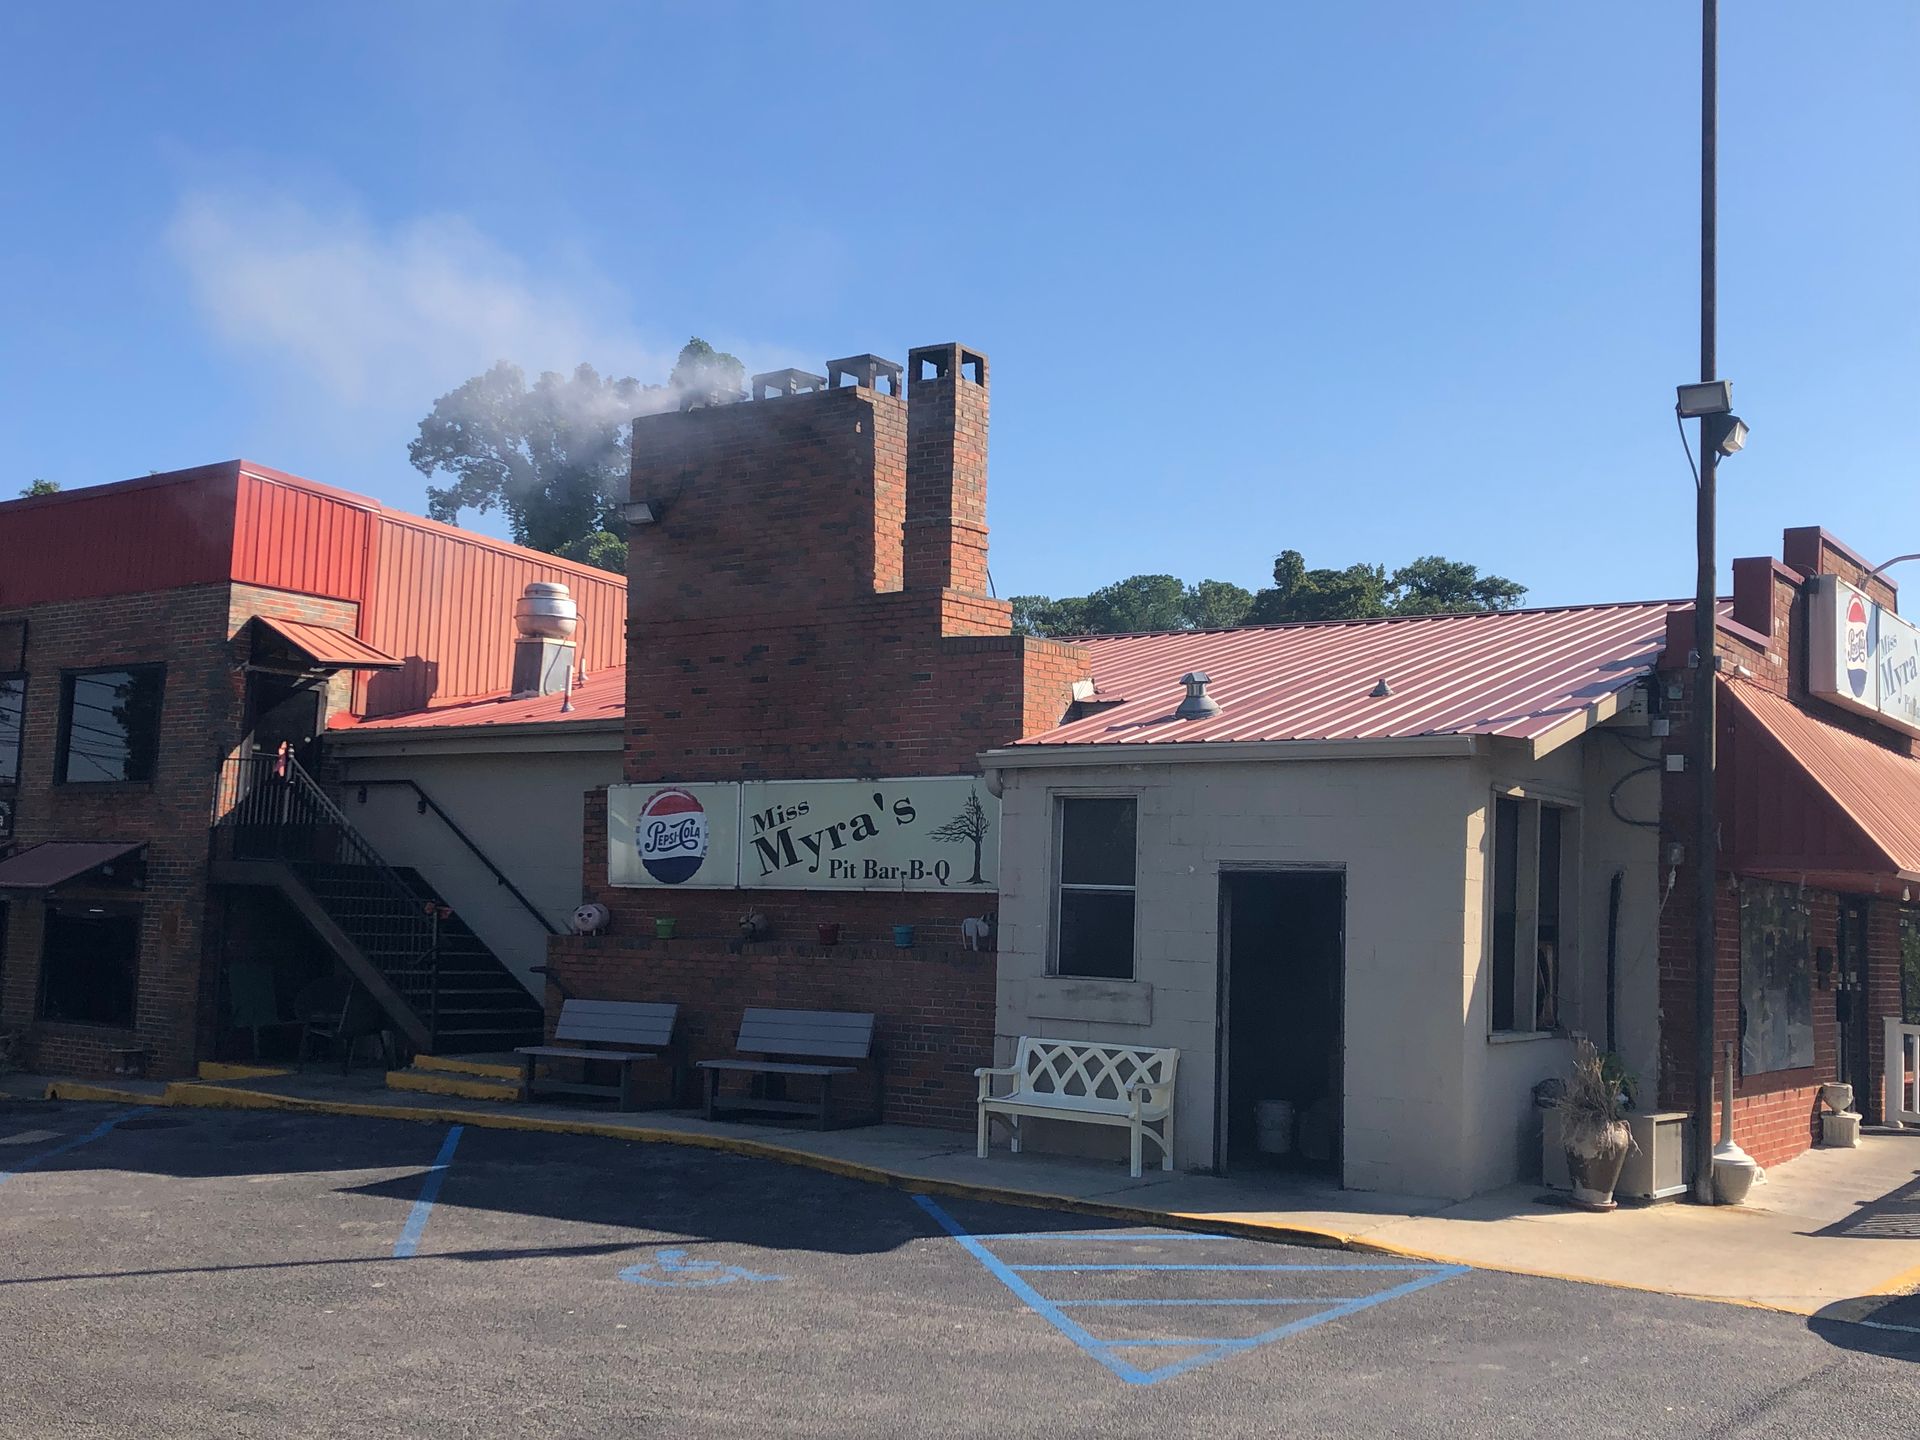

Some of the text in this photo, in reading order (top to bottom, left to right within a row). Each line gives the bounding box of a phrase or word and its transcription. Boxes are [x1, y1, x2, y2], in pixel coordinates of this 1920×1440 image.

[1880, 634, 1898, 660] Miss
[750, 800, 810, 836] Miss
[750, 792, 917, 877] Myra's
[828, 859, 950, 887] Pit Bar-B-Q
